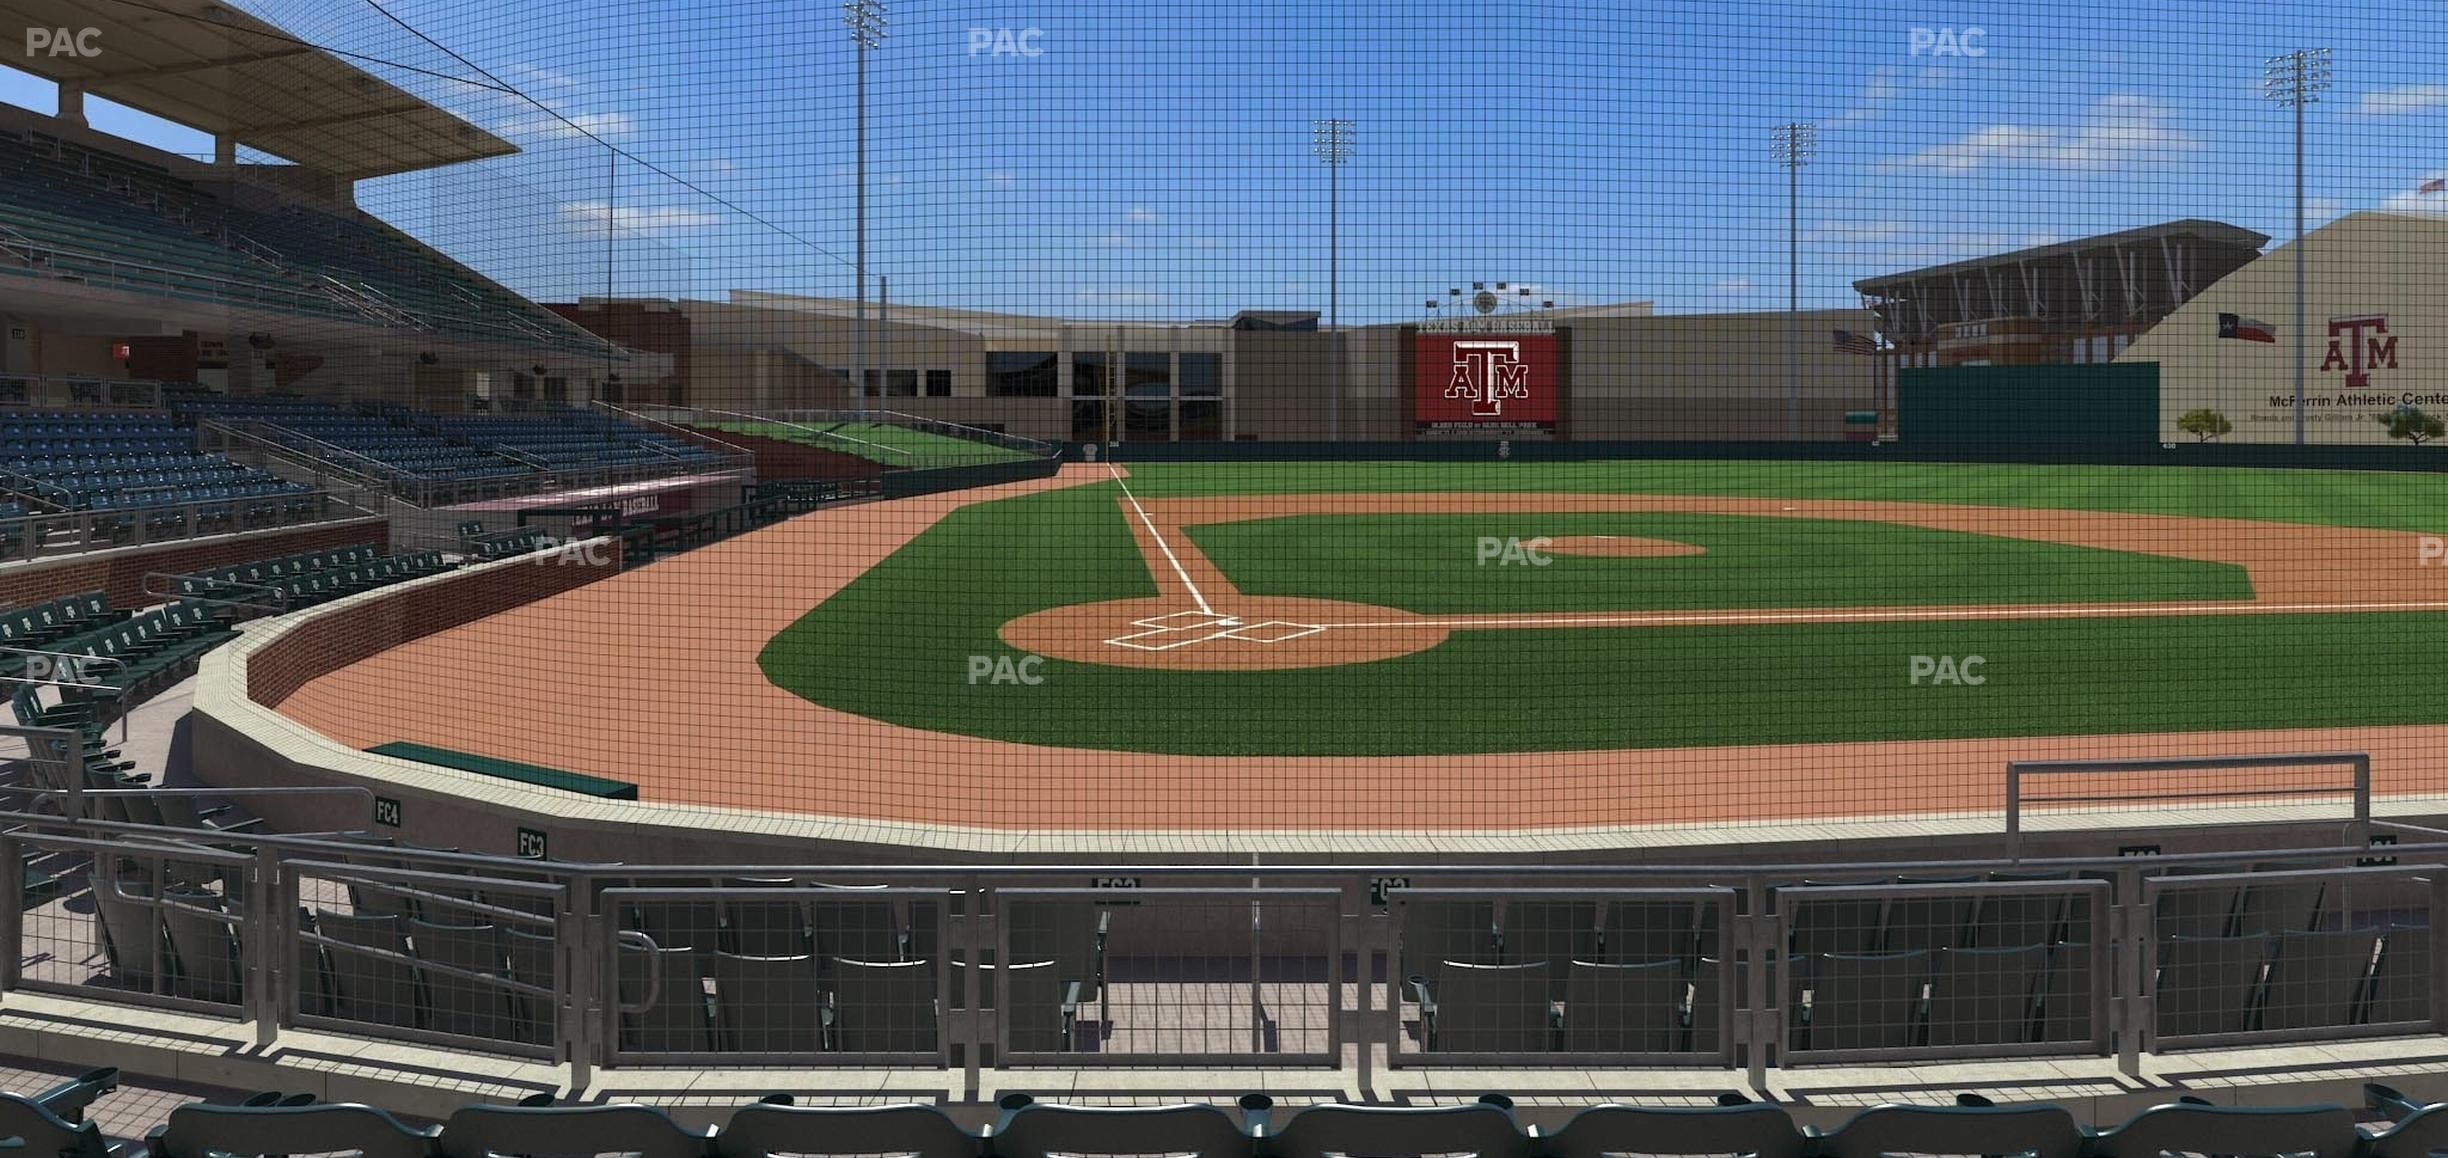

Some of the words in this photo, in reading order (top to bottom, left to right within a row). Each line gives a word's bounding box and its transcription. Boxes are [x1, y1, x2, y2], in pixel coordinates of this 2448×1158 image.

[2269, 395, 2331, 408] McFrrin
[2336, 393, 2395, 407] Athletic
[377, 801, 399, 825] FC4
[520, 831, 544, 857] FC3
